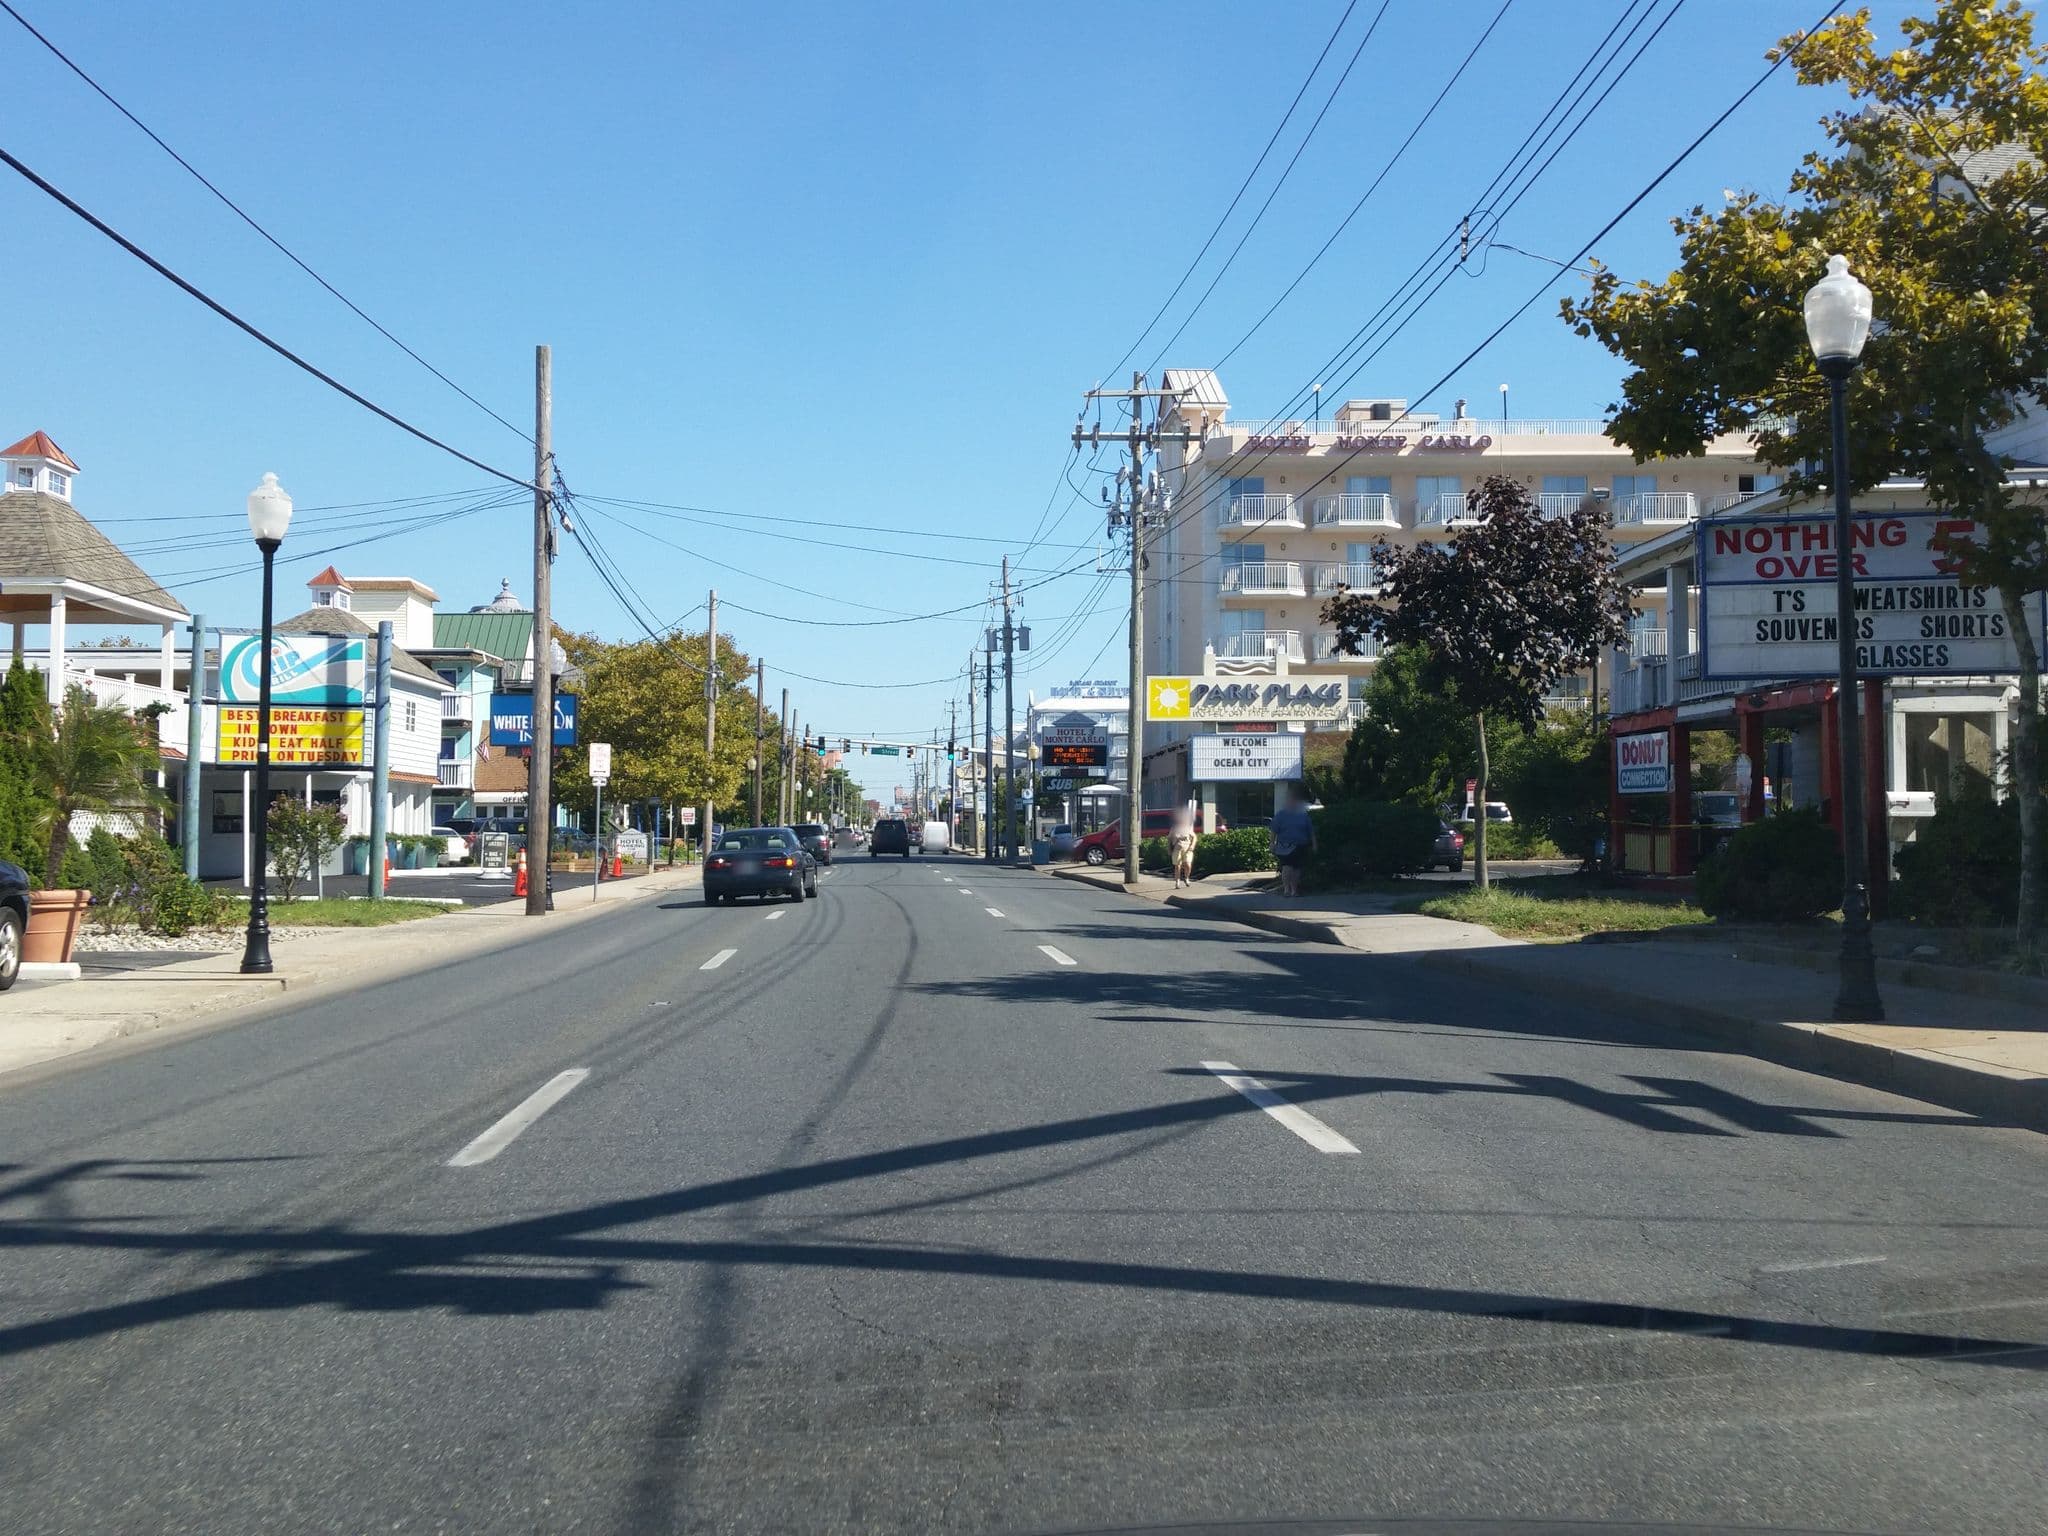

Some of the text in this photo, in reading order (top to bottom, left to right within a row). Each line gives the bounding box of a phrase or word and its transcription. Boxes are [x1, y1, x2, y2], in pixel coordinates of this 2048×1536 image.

[1248, 434, 1493, 449] HOTEL MONTE CARLO
[1715, 520, 1907, 555] NOTHNG
[1773, 585, 1986, 613] T'S WEATSHIRTS
[1755, 613, 2004, 642] SOUVENS SHORTS
[1190, 682, 1343, 704] PARK PLACE
[227, 710, 345, 722] BEST BREAKFAST
[493, 715, 529, 729] WHITE
[237, 723, 298, 735] IN OWN
[1056, 728, 1087, 736] HOTEL
[279, 738, 304, 748] EAT
[311, 738, 344, 749] HALF
[1045, 736, 1105, 744] MONTE CARLO
[1223, 738, 1268, 747] WELCOME
[277, 750, 294, 761] ON
[299, 750, 358, 762] TUESDAY
[1239, 748, 1251, 757] TO
[1622, 739, 1664, 766] DONUT
[1213, 758, 1269, 767] OCEAN CITY
[1621, 769, 1666, 787] CONNECTION
